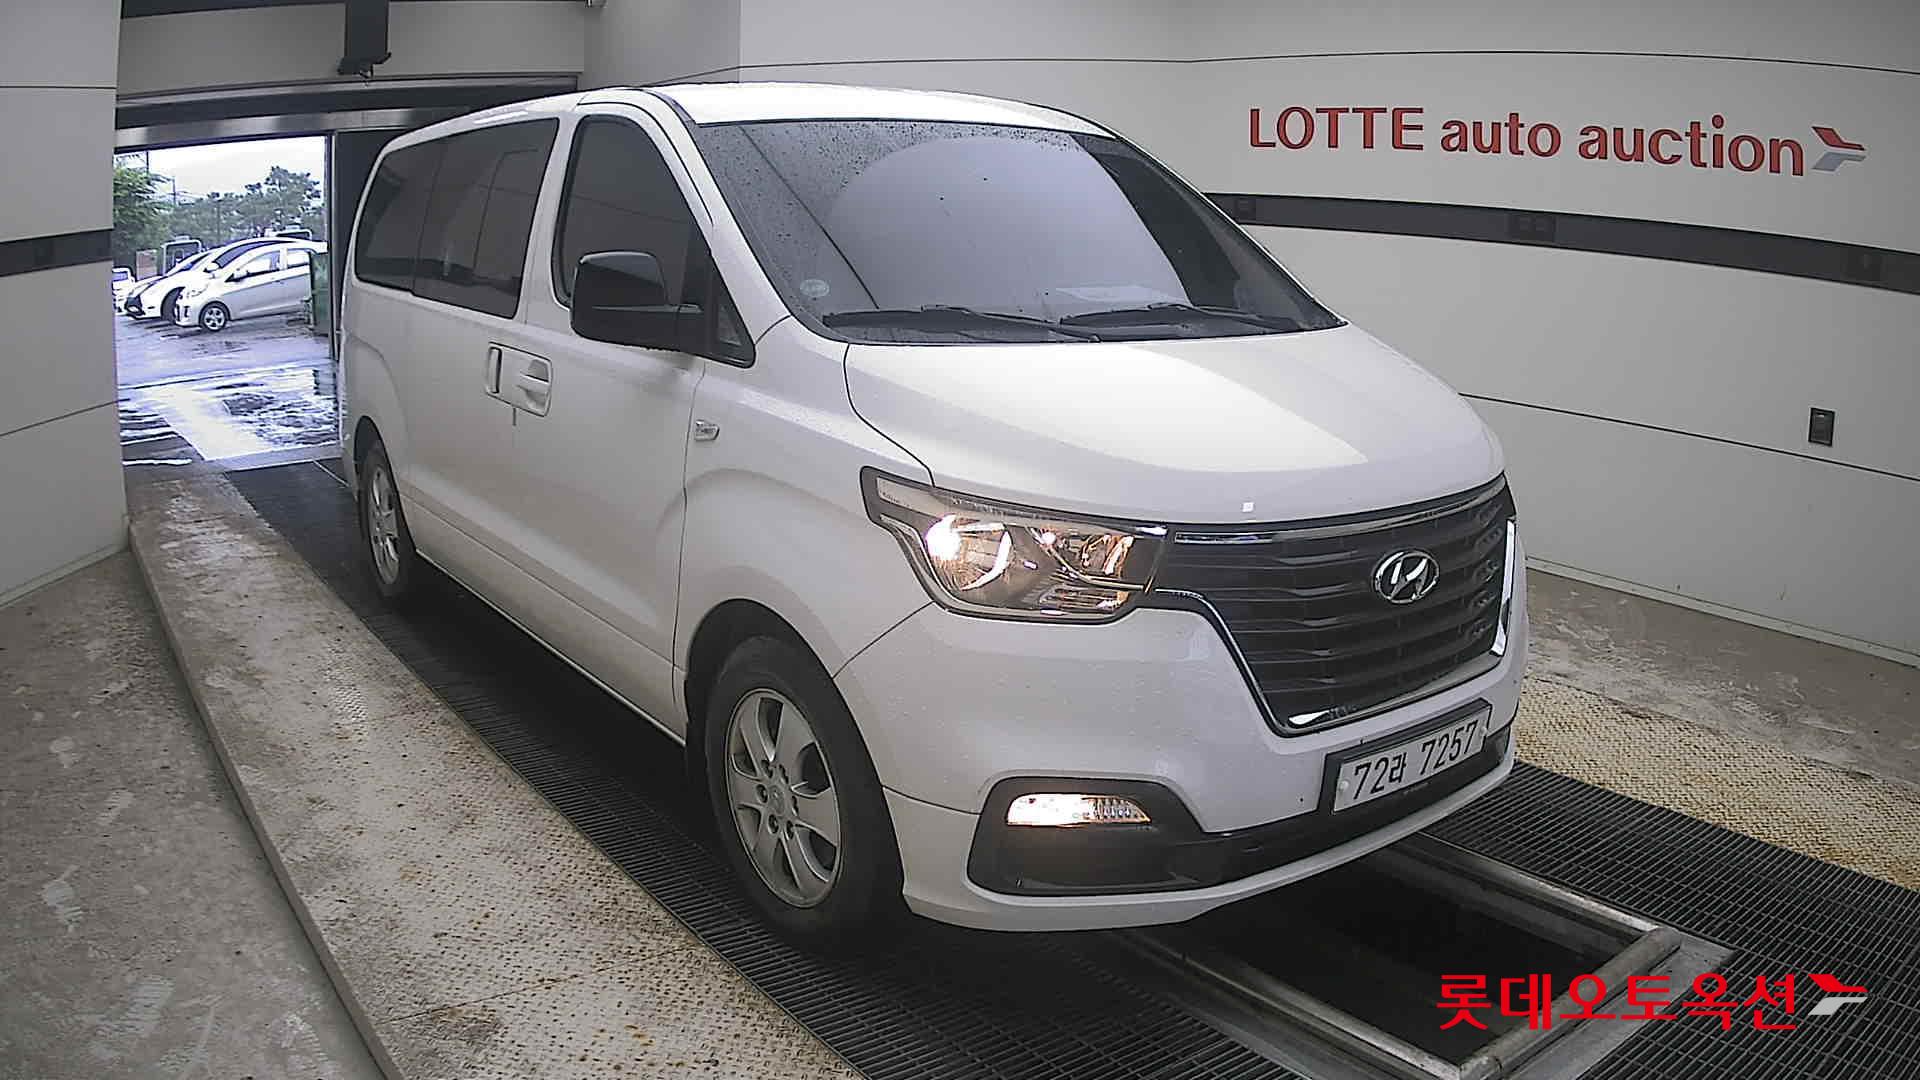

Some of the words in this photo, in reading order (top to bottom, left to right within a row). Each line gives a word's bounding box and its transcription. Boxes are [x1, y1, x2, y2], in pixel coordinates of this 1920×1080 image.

[1249, 106, 1424, 150] LOTTE
[1440, 112, 1561, 157] auto
[1578, 116, 1804, 176] auction
[1354, 752, 1407, 799] 72라
[1419, 719, 1479, 775] 7257
